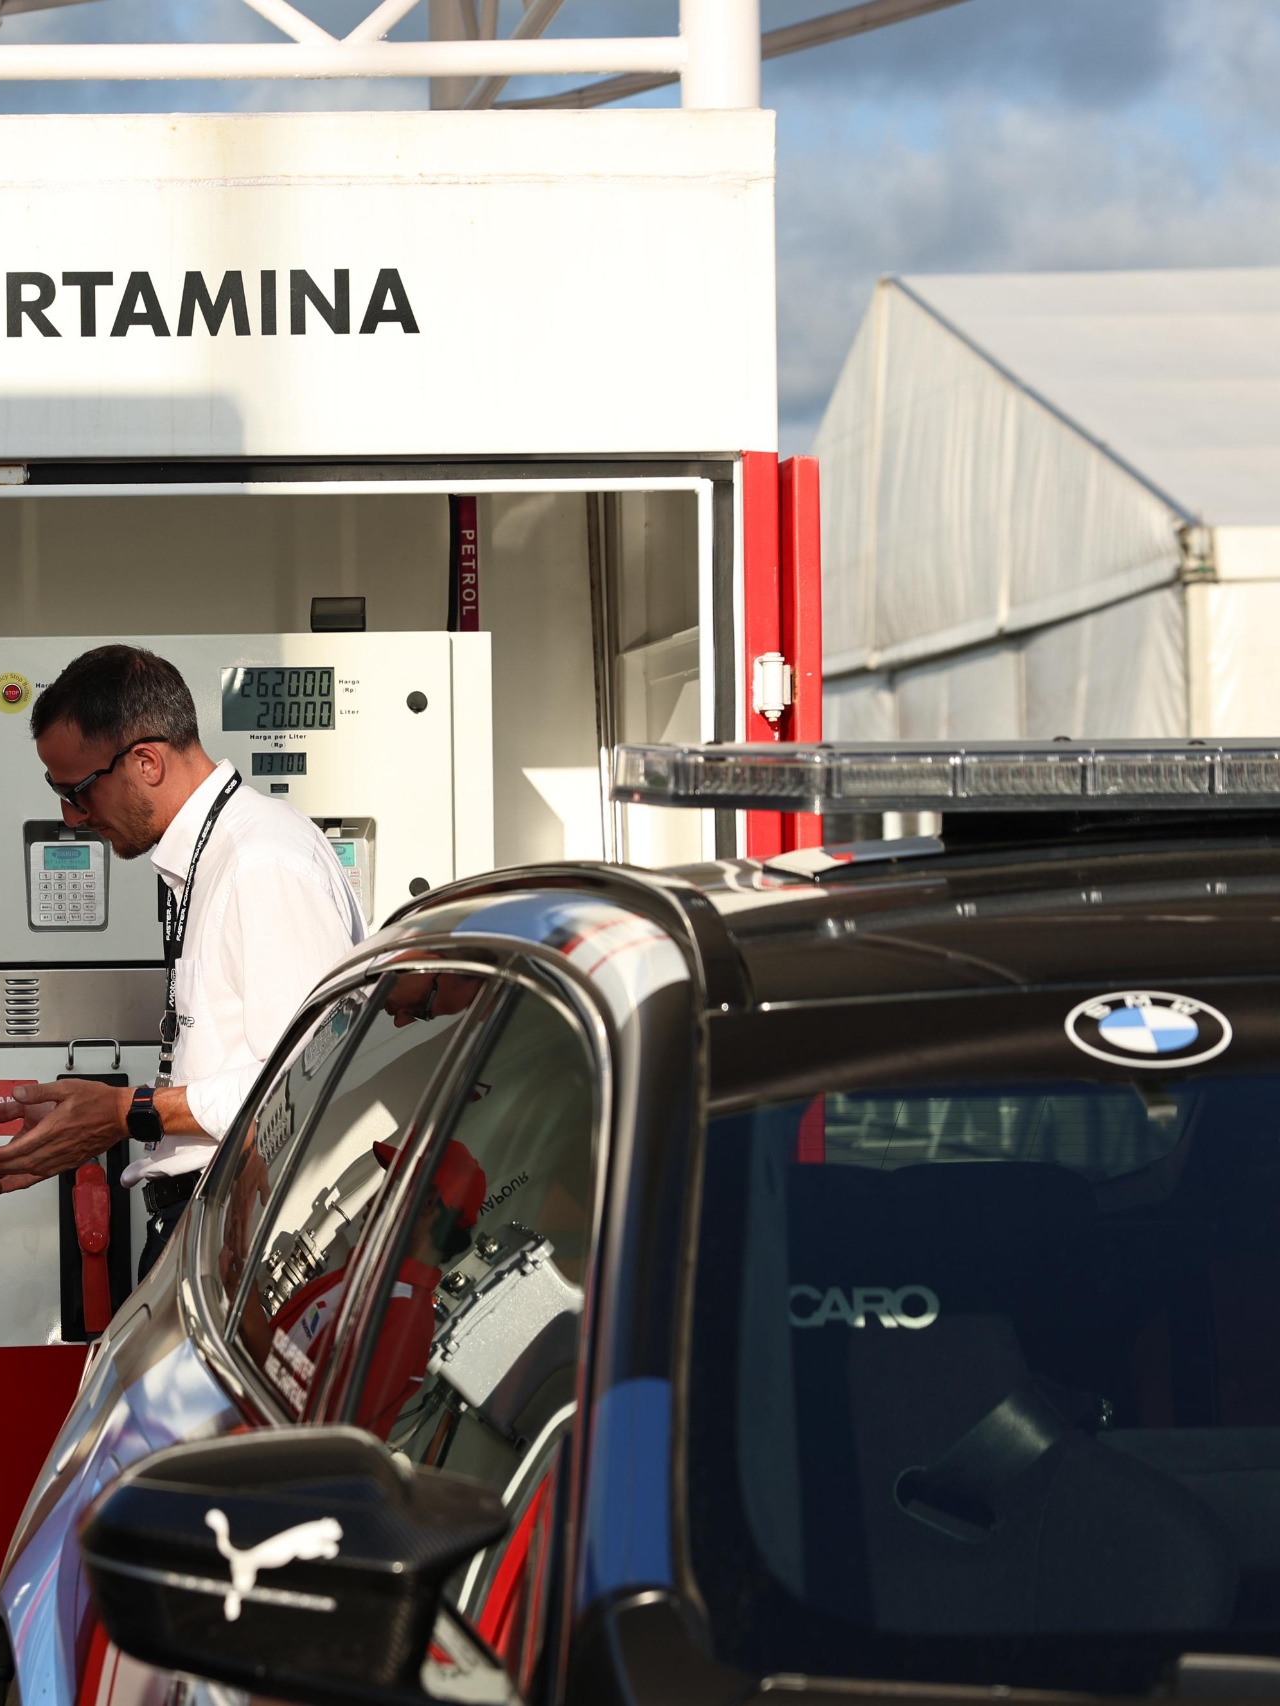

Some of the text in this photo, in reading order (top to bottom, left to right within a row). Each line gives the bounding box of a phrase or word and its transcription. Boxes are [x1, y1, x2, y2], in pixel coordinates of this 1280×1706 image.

[461, 529, 476, 616] PETROL
[9, 673, 23, 683] Stop
[240, 670, 332, 698] 262000
[256, 701, 332, 728] 20.000
[258, 754, 305, 772] 13100
[1083, 994, 1201, 1020] BMW
[787, 1284, 941, 1330] CARO
